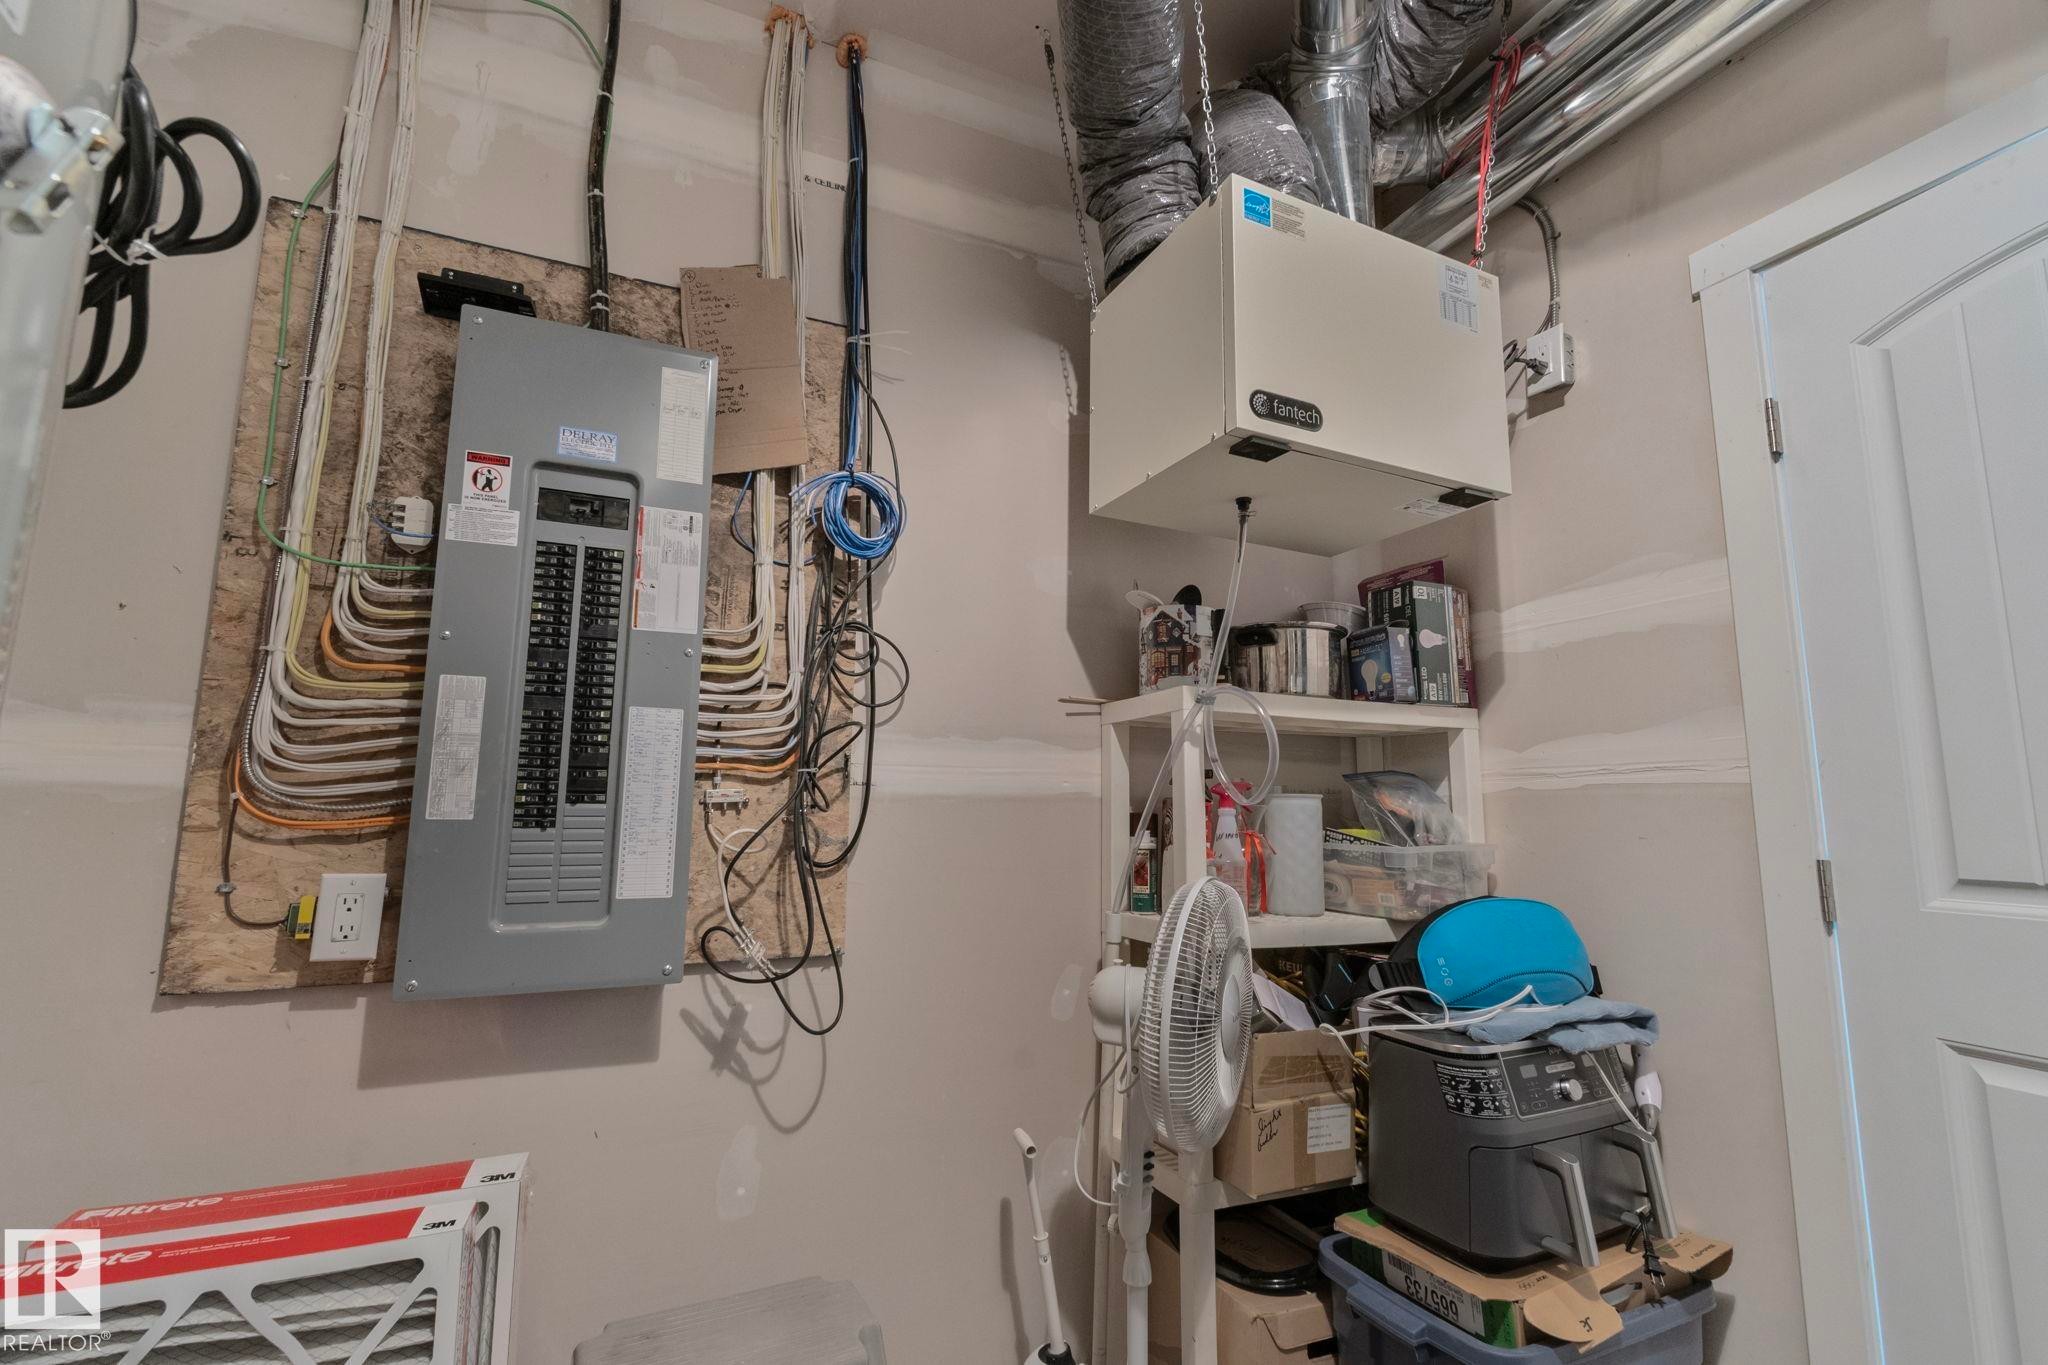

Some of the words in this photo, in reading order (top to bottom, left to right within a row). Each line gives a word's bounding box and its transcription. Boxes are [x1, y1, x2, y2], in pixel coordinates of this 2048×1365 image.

[814, 177, 849, 193] CEILIN
[1272, 399, 1320, 424] fantech
[562, 428, 614, 444] DELRAY
[471, 453, 507, 464] WARNING
[480, 1172, 516, 1183] 3M
[75, 1196, 224, 1221] Filtrete
[422, 1219, 457, 1230] 3M
[0, 1249, 153, 1280] iltrete
[1404, 1275, 1459, 1321] 665733
